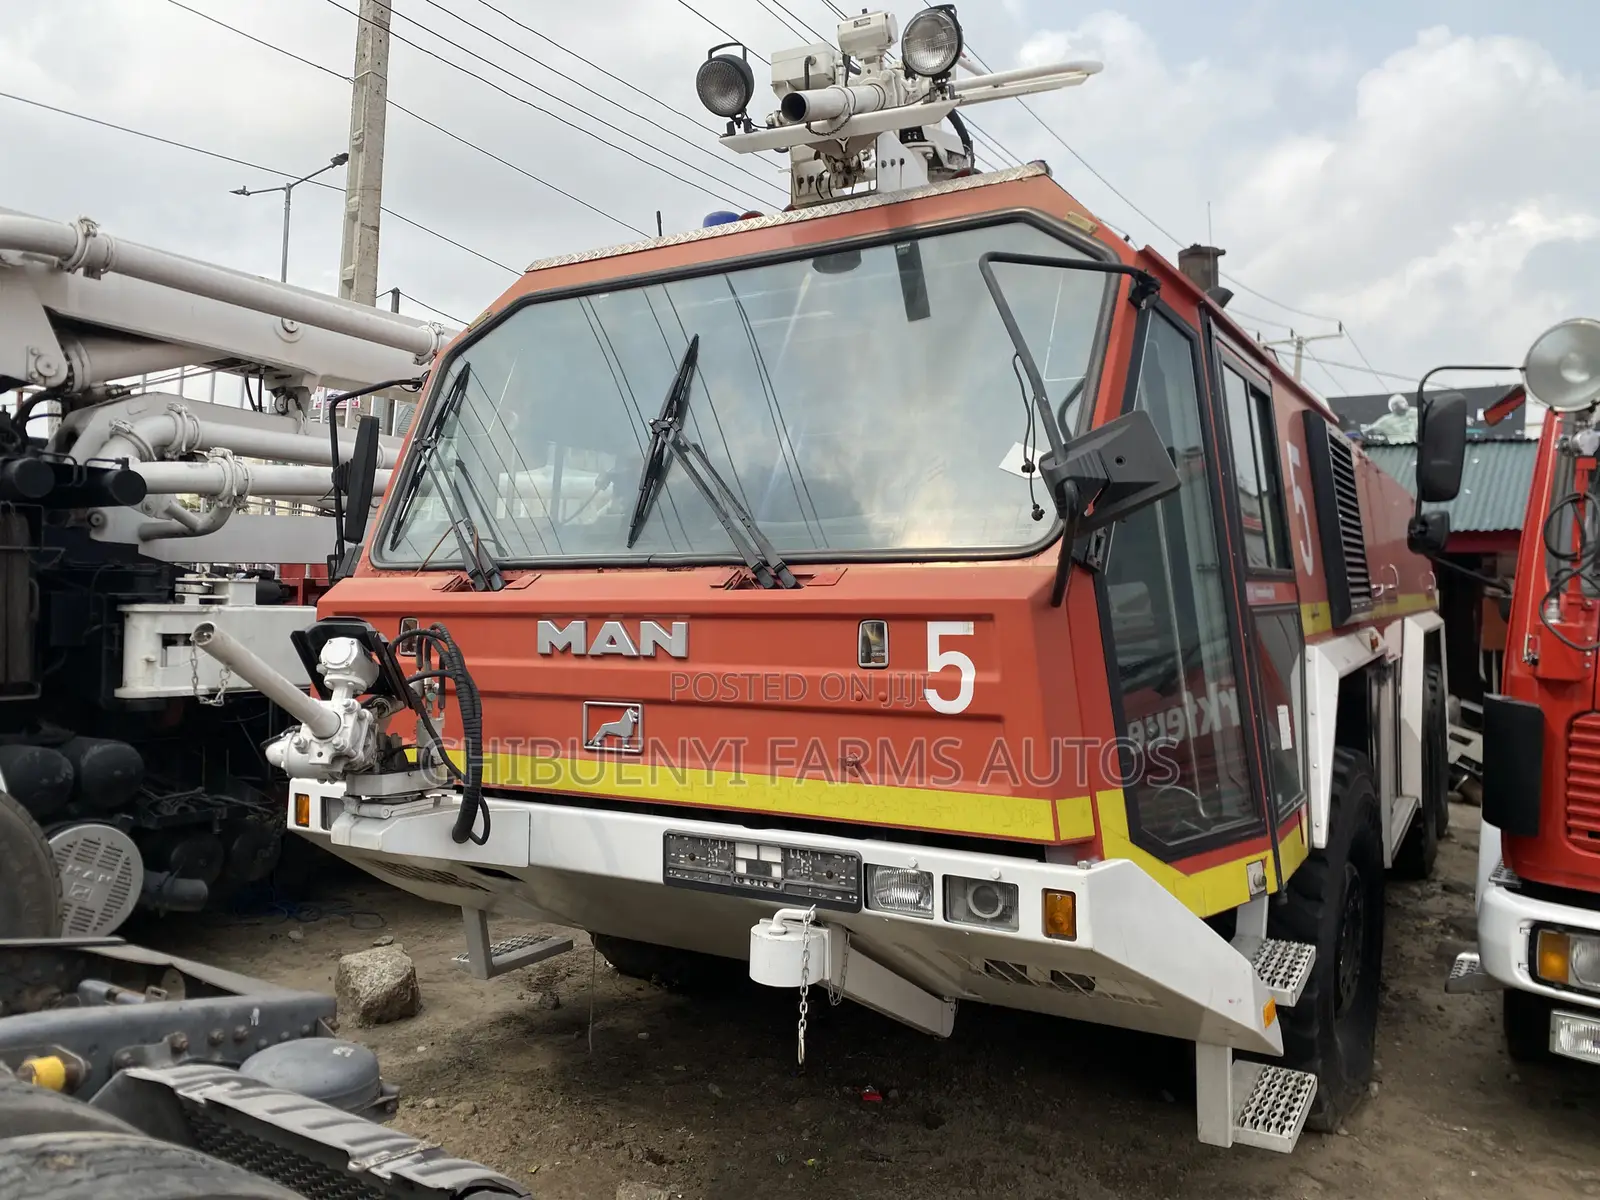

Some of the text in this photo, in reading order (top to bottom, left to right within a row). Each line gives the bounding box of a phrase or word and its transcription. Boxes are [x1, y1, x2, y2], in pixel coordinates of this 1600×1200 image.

[1286, 441, 1314, 577] 5
[537, 620, 689, 659] MAN
[924, 621, 977, 714] 5
